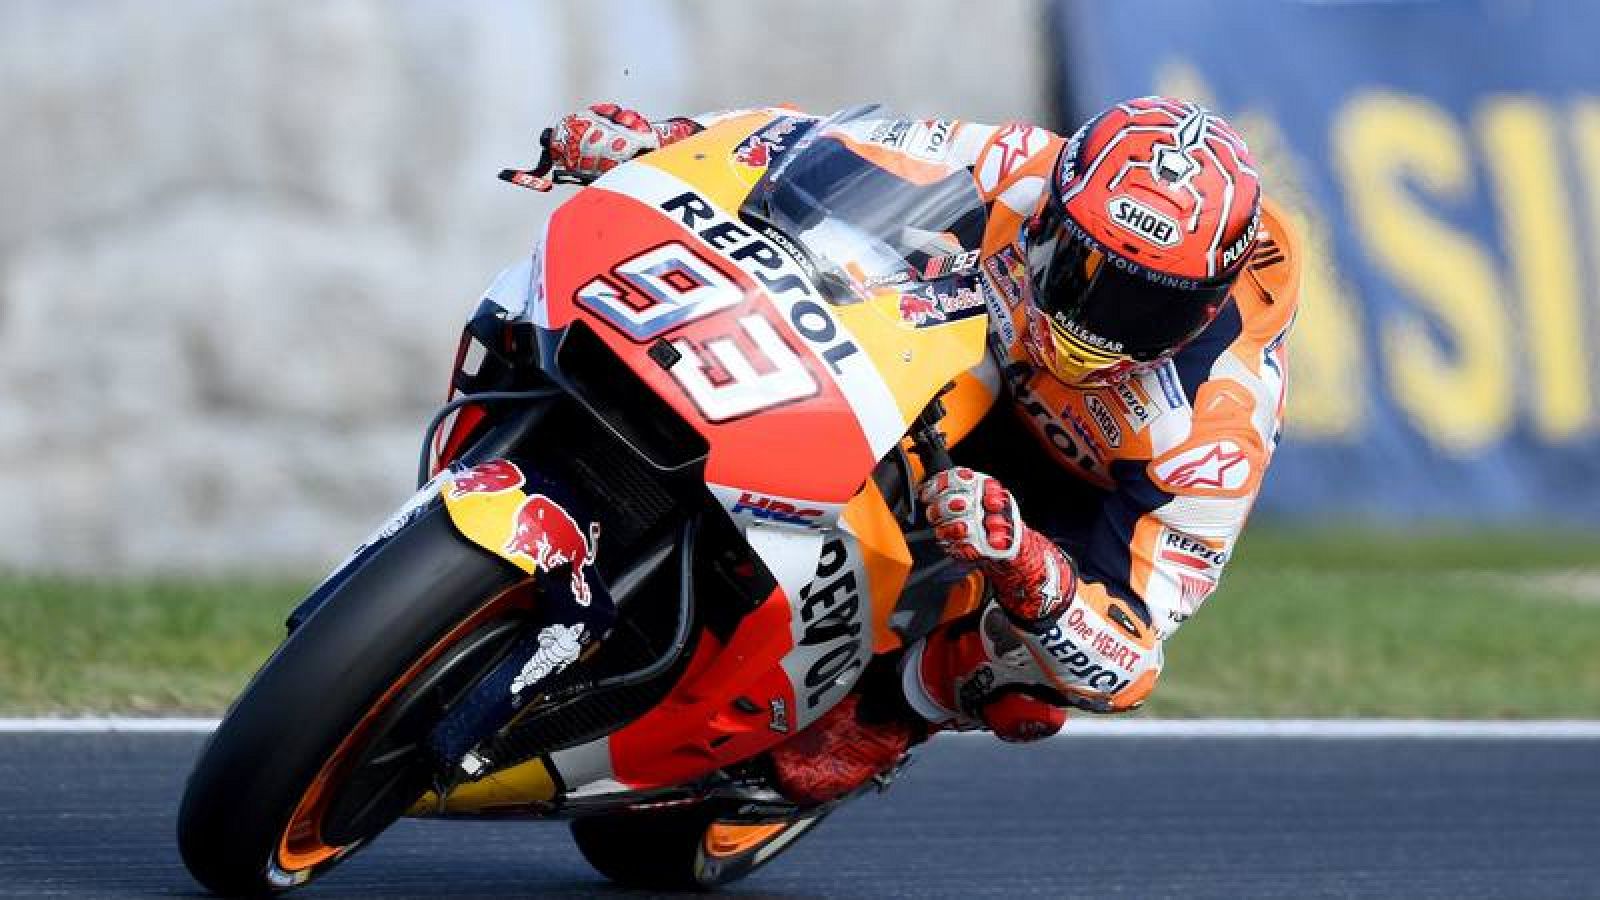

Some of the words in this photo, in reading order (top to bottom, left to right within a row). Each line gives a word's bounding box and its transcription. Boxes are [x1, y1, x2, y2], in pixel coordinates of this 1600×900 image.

[1115, 201, 1173, 243] SHOEI
[662, 190, 862, 376] REPSOL
[575, 240, 819, 424] 93
[731, 493, 823, 525] HRC
[1067, 607, 1093, 643] One
